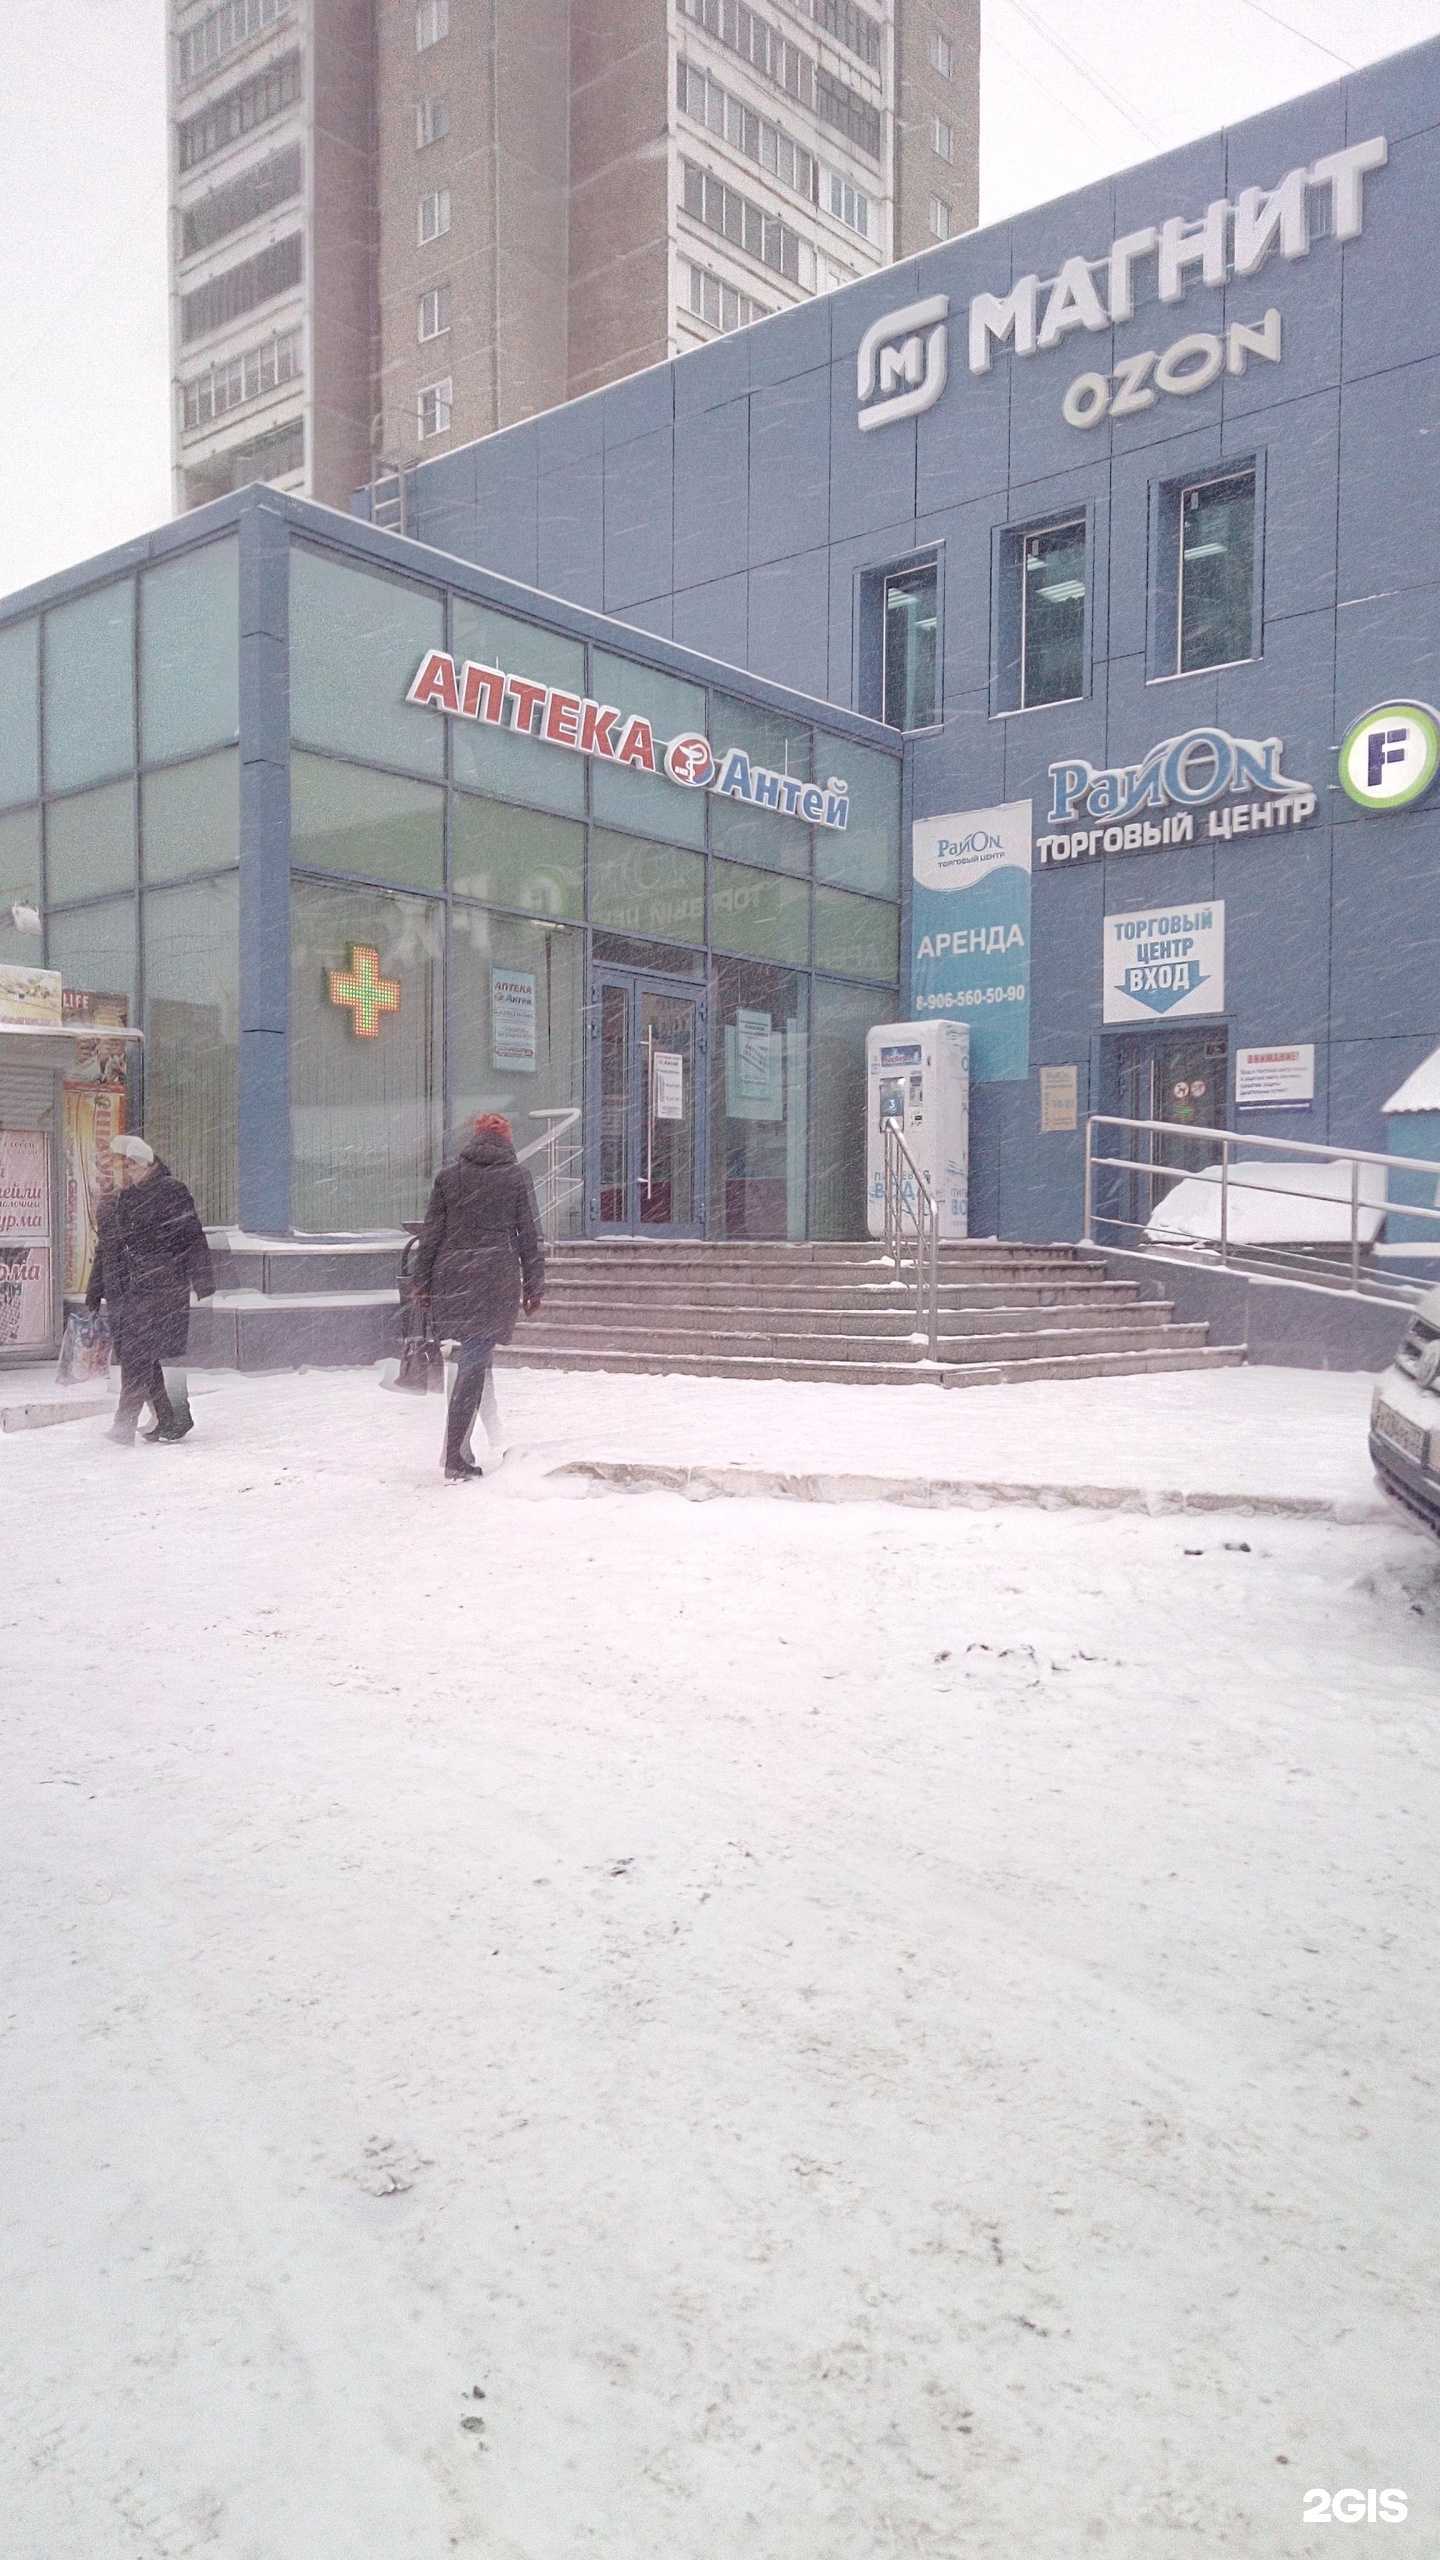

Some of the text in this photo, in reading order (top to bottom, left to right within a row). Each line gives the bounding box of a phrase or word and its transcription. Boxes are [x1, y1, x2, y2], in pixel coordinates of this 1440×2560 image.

[968, 136, 1388, 375] МАГНИТ
[1063, 308, 1281, 429] OZON
[408, 650, 849, 830] АПТЕКА Антей
[1036, 793, 1317, 862] ТОРГОВЫЙ ЦЕНТР
[917, 924, 1024, 959] АРЕНДА
[1114, 907, 1212, 941] ТОРГОВЫЙ
[1137, 938, 1193, 964] ЦЕНТР
[1130, 961, 1190, 992] ВХОД
[916, 985, 1025, 1010] 8-906-560-50-90
